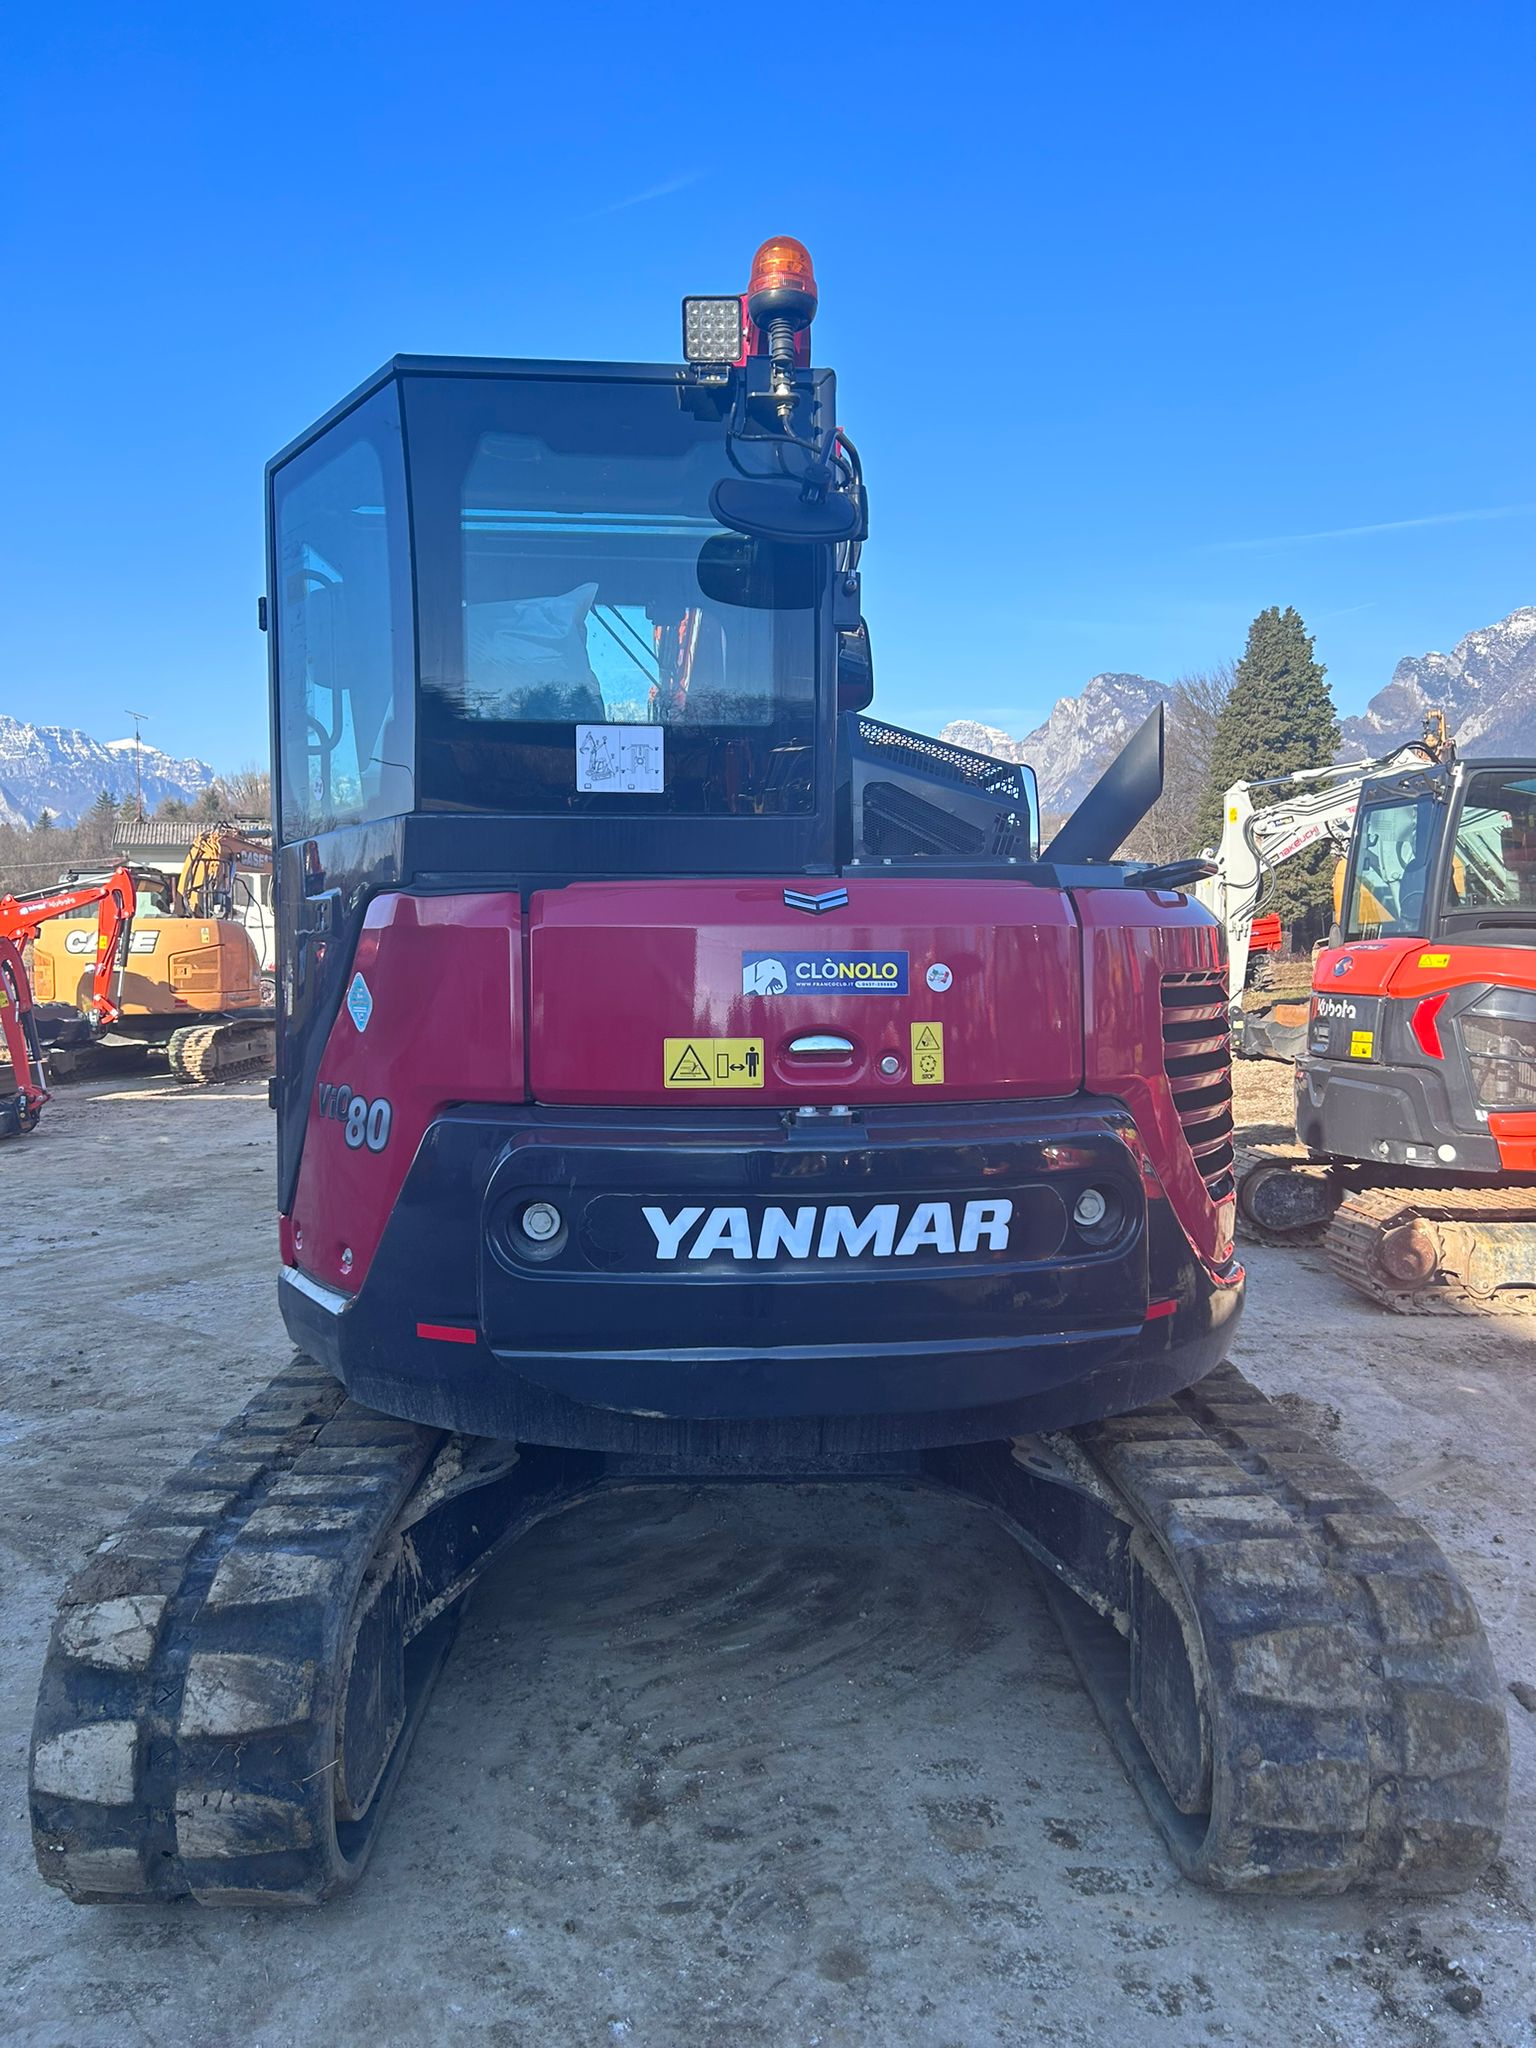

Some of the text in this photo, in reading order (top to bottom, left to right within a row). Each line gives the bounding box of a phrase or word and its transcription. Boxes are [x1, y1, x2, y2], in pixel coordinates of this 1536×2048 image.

[65, 930, 161, 954] CAE
[795, 957, 898, 979] CLÒNOLO
[1318, 998, 1357, 1019] Kubota
[641, 1199, 1013, 1259] YANMAR
